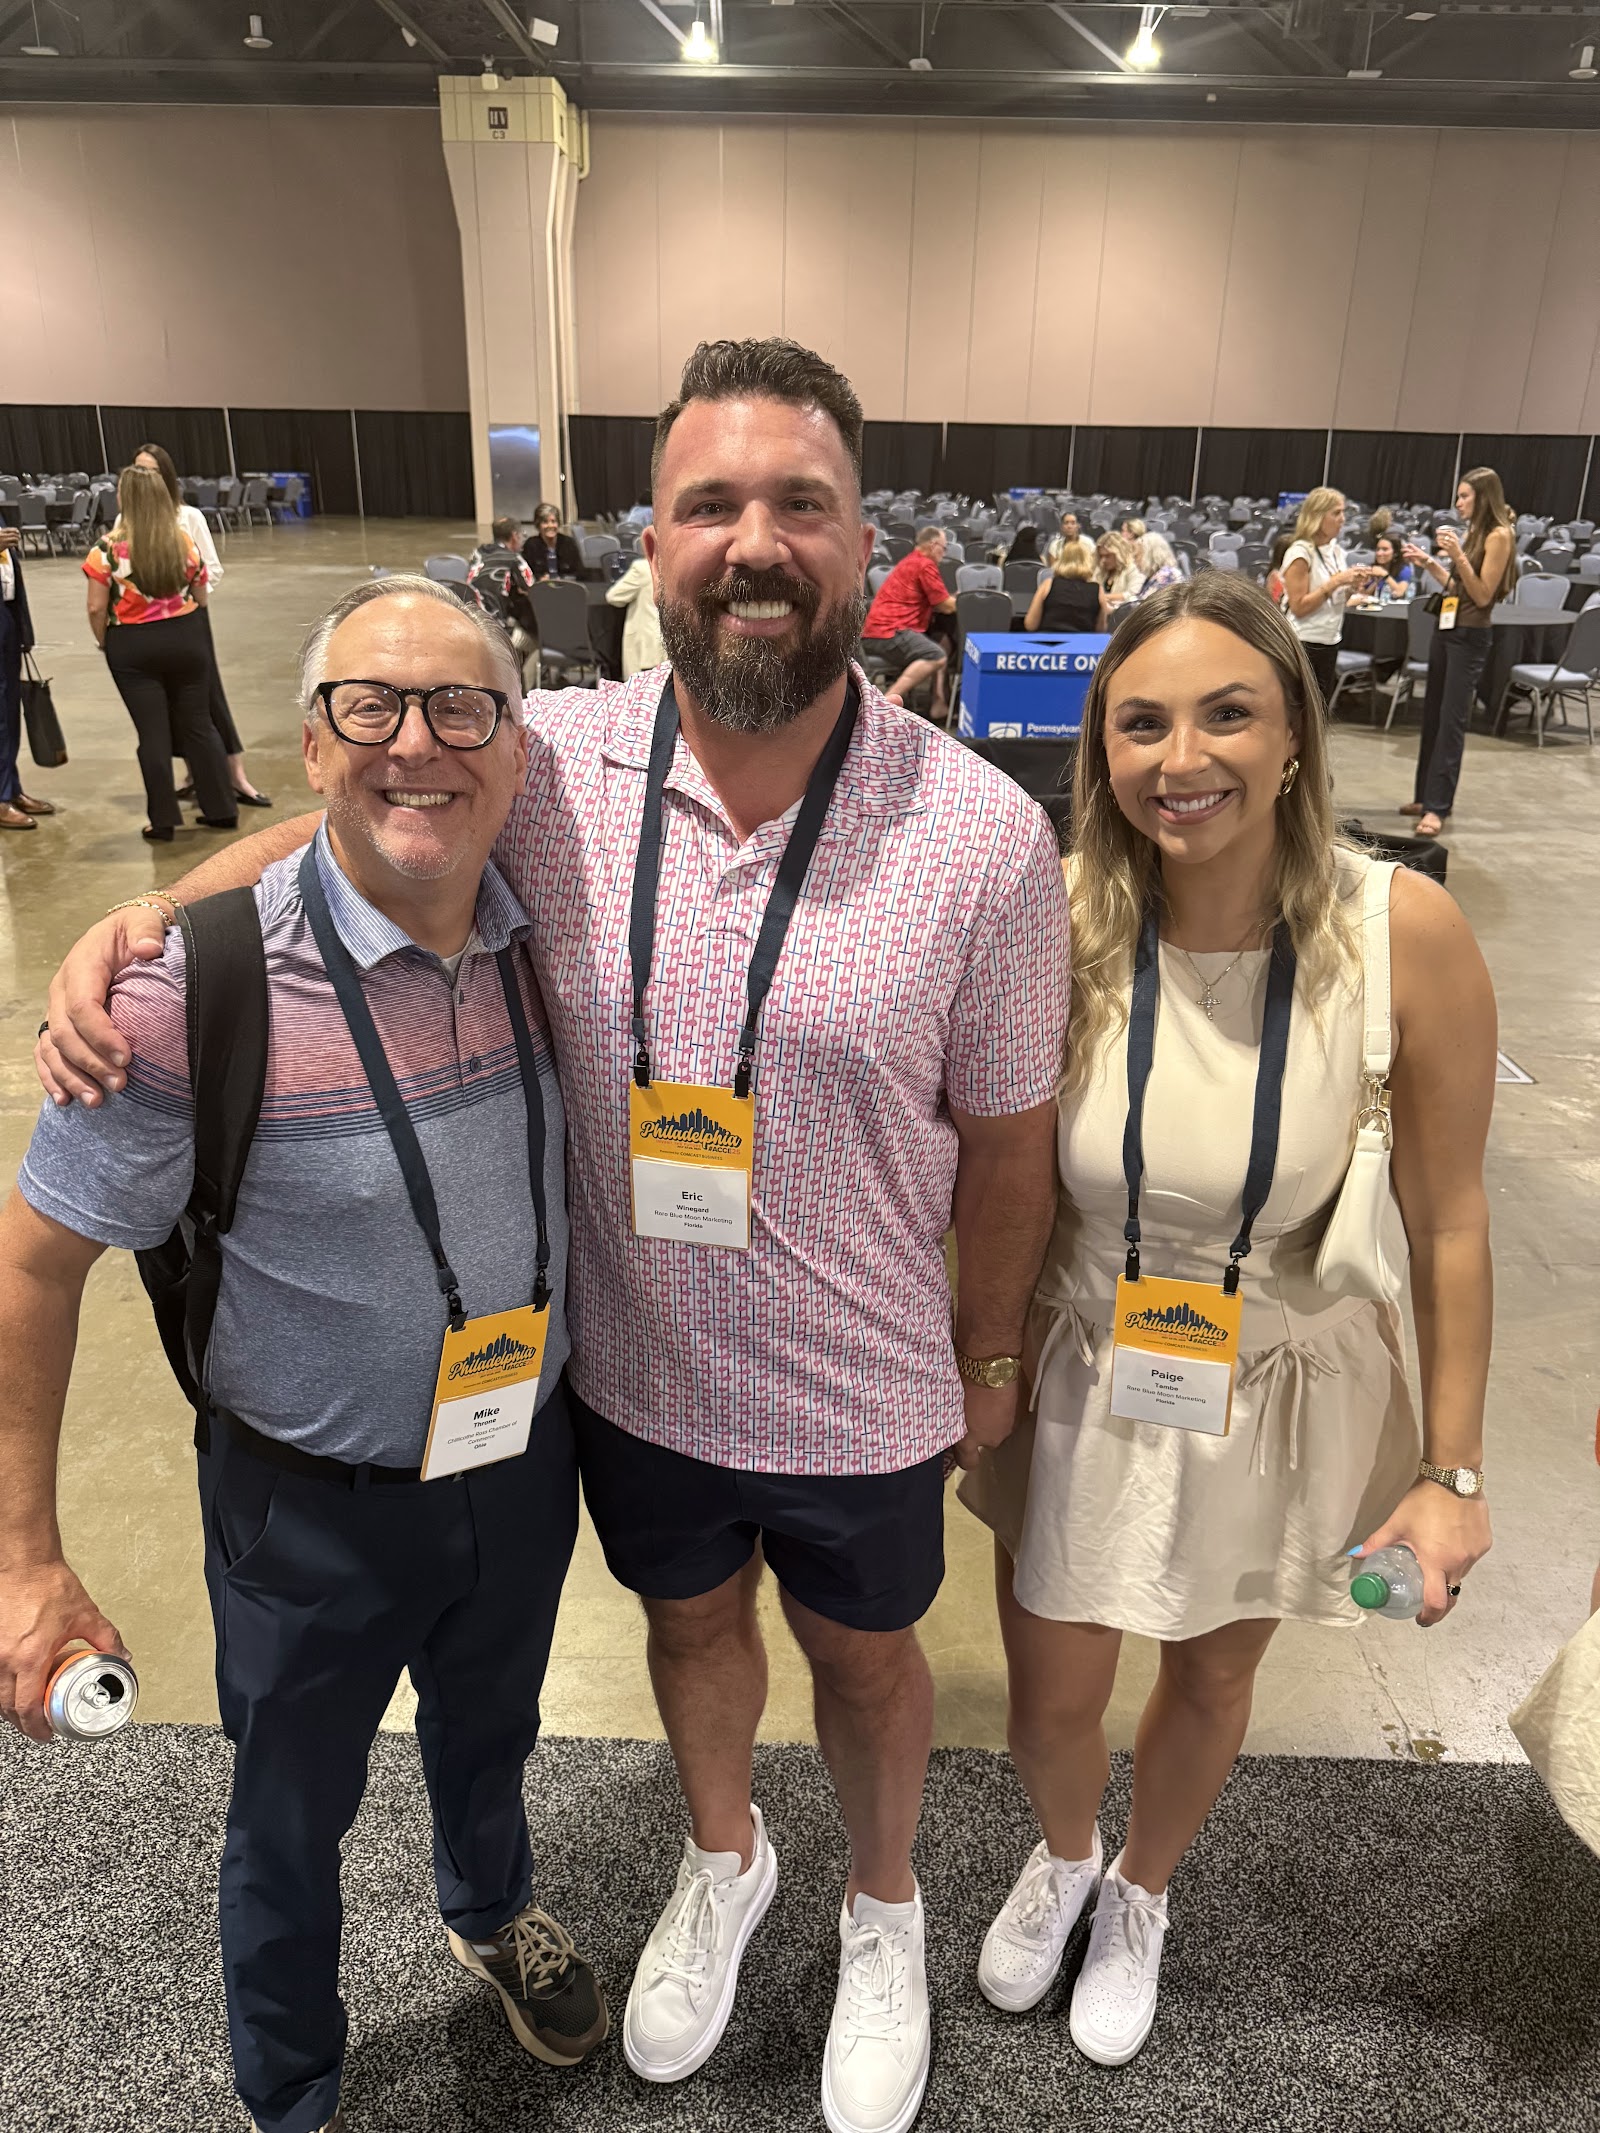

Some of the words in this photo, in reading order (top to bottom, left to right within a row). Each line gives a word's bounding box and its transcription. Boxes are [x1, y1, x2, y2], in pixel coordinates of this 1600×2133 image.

[996, 654, 1068, 671] RECYCLE
[1074, 655, 1102, 671] ON
[1026, 722, 1083, 734] Pennsylvan
[640, 1120, 742, 1151] Philadelphia
[682, 1191, 703, 1201] Eric
[676, 1204, 709, 1213] Winegard
[702, 1216, 733, 1225] Marketing
[1125, 1311, 1229, 1341] Philadelphia
[448, 1346, 537, 1381] Philadelphia
[1151, 1369, 1184, 1382] Paige
[1155, 1382, 1179, 1392] Tambe
[1126, 1384, 1141, 1392] Rare
[1142, 1387, 1156, 1395] Blue
[1157, 1390, 1175, 1398] Moon
[1175, 1394, 1207, 1404] Marketing
[473, 1407, 500, 1420] Mike
[473, 1418, 497, 1428] Throne
[488, 1422, 511, 1433] Chamber
[467, 1434, 496, 1445] Commerce
